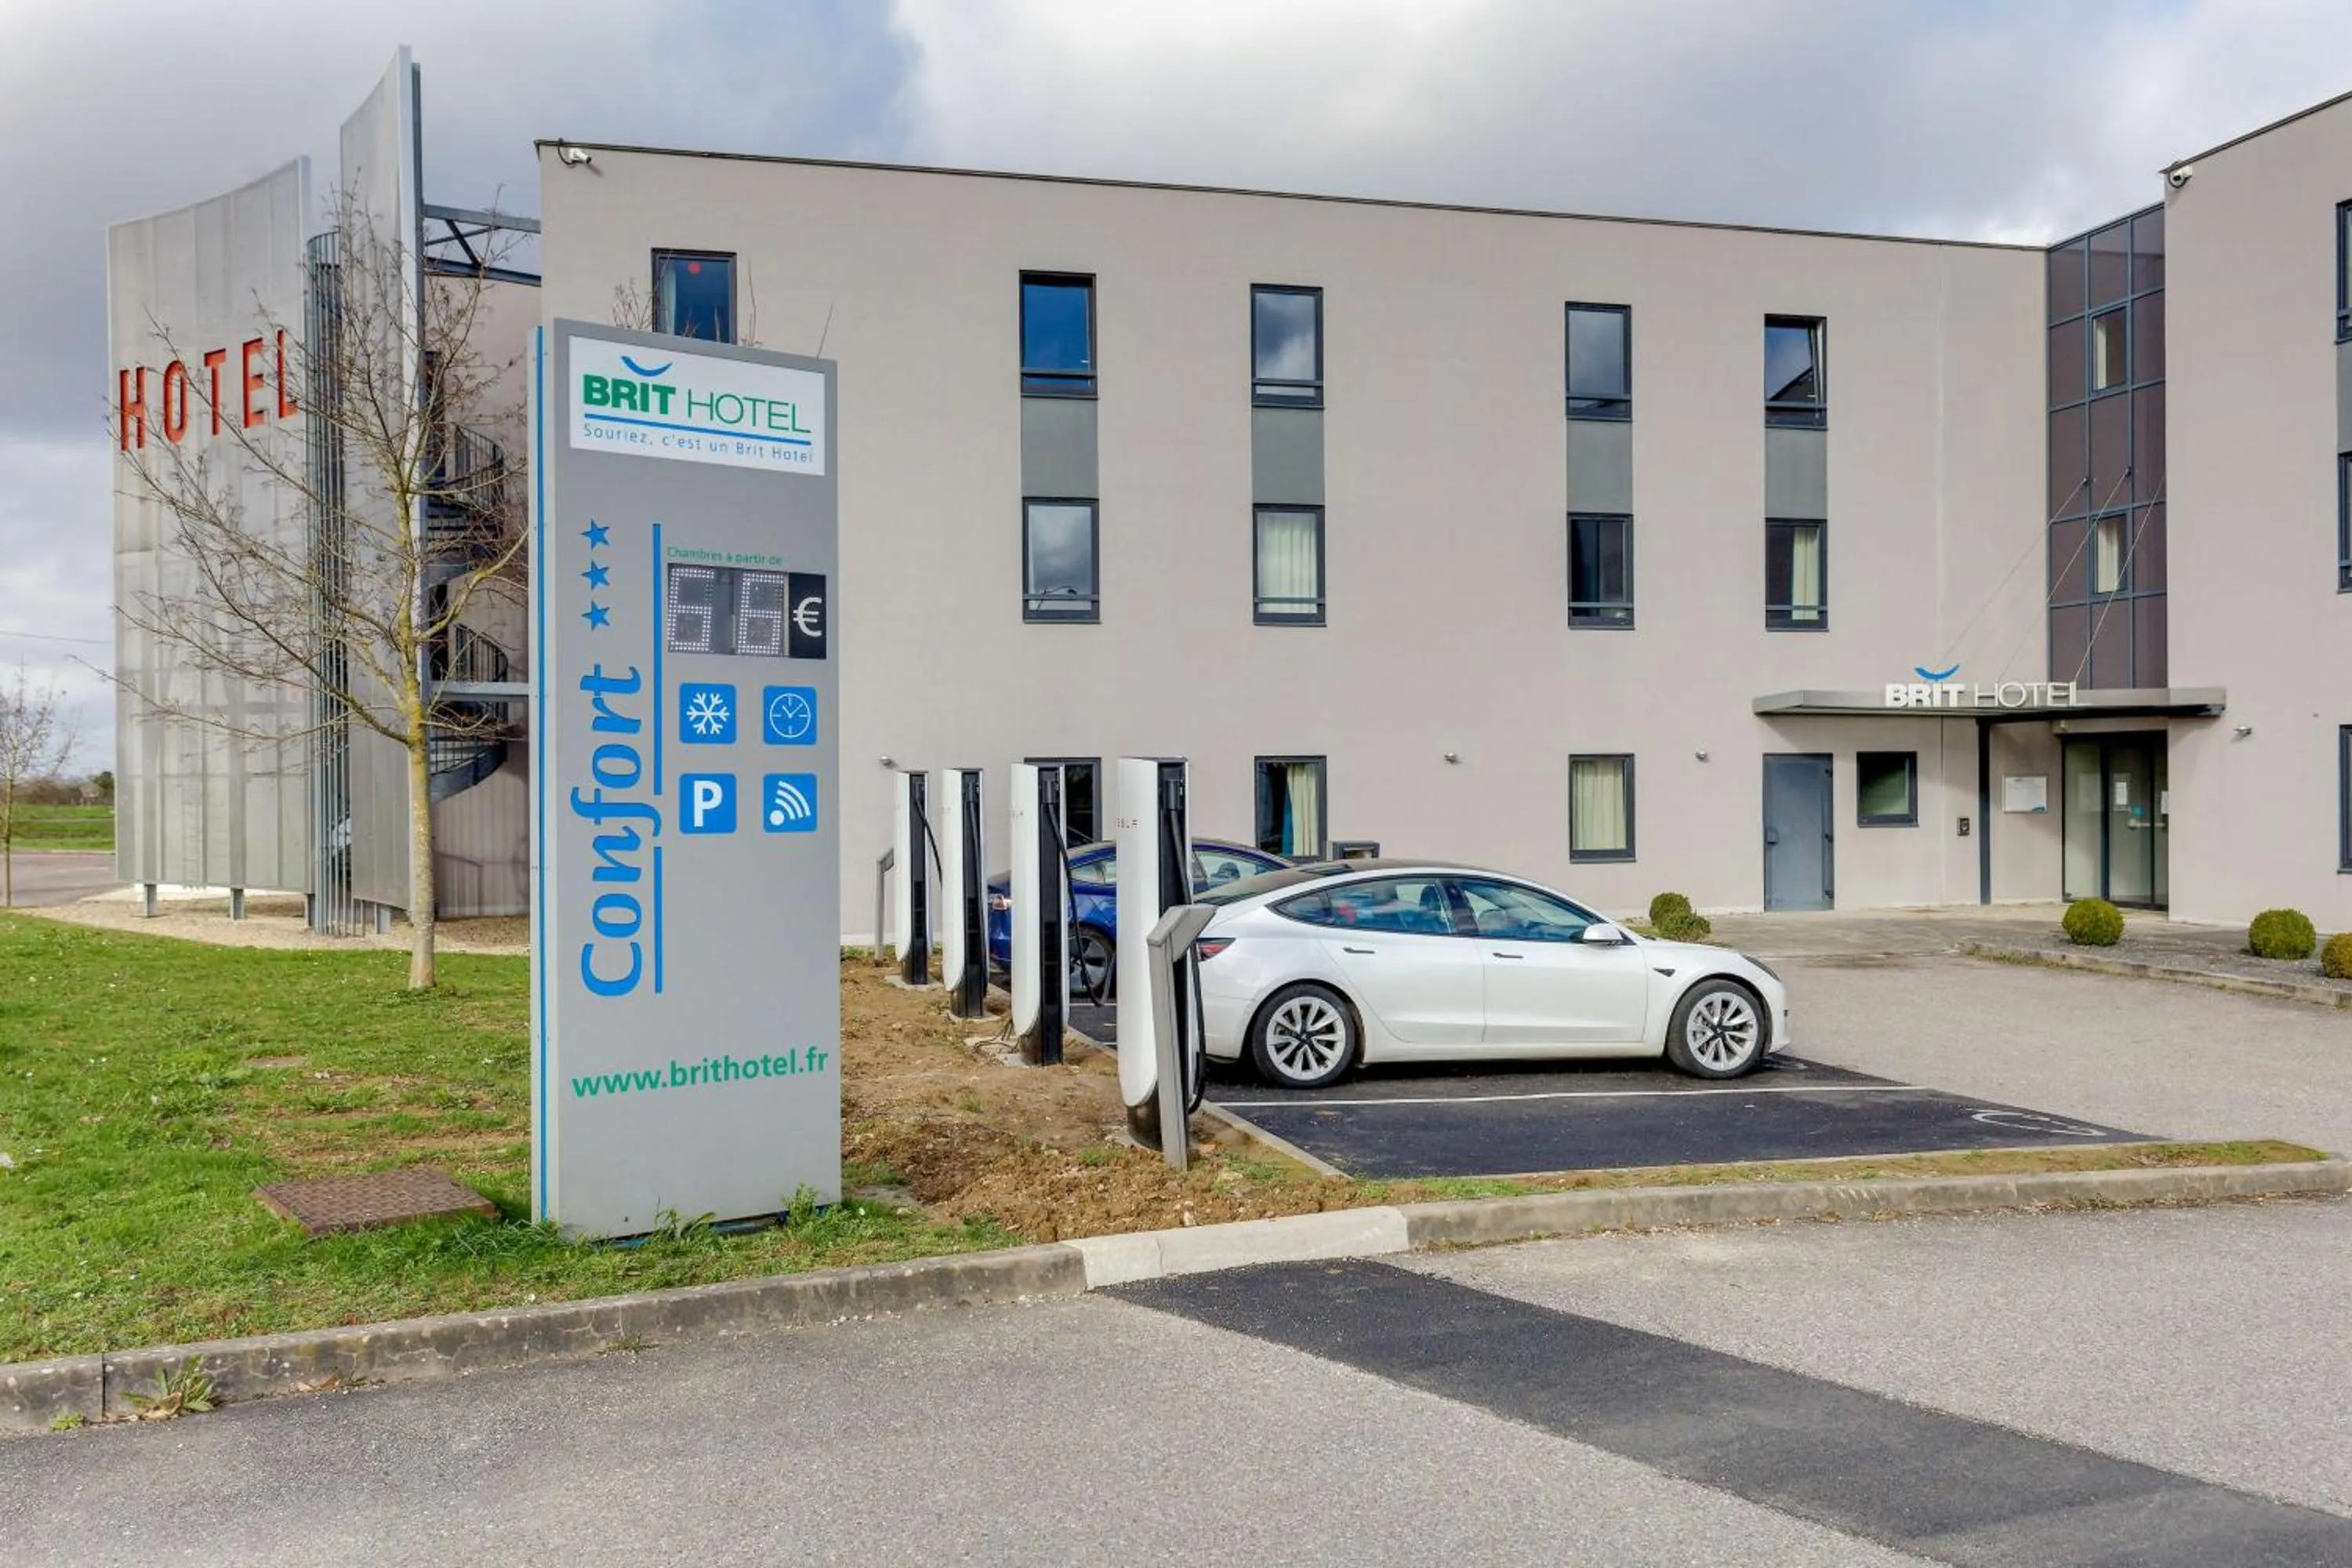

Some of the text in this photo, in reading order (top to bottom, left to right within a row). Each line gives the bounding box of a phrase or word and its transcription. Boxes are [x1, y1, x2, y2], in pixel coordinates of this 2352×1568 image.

[119, 328, 297, 452] HOTEL
[583, 374, 811, 434] BRIT HOTEL
[662, 434, 701, 451] c'est
[710, 441, 728, 453] un
[736, 442, 764, 458] Brit
[772, 447, 814, 463] Hotel
[668, 547, 721, 561] Chambres
[735, 552, 766, 566] partir
[770, 555, 782, 565] de
[793, 597, 822, 637] €
[1886, 681, 2092, 707] BRIT HOTEL
[693, 780, 724, 827] P
[570, 663, 662, 997] Confort
[572, 1046, 829, 1097] www.brithotel.fr
